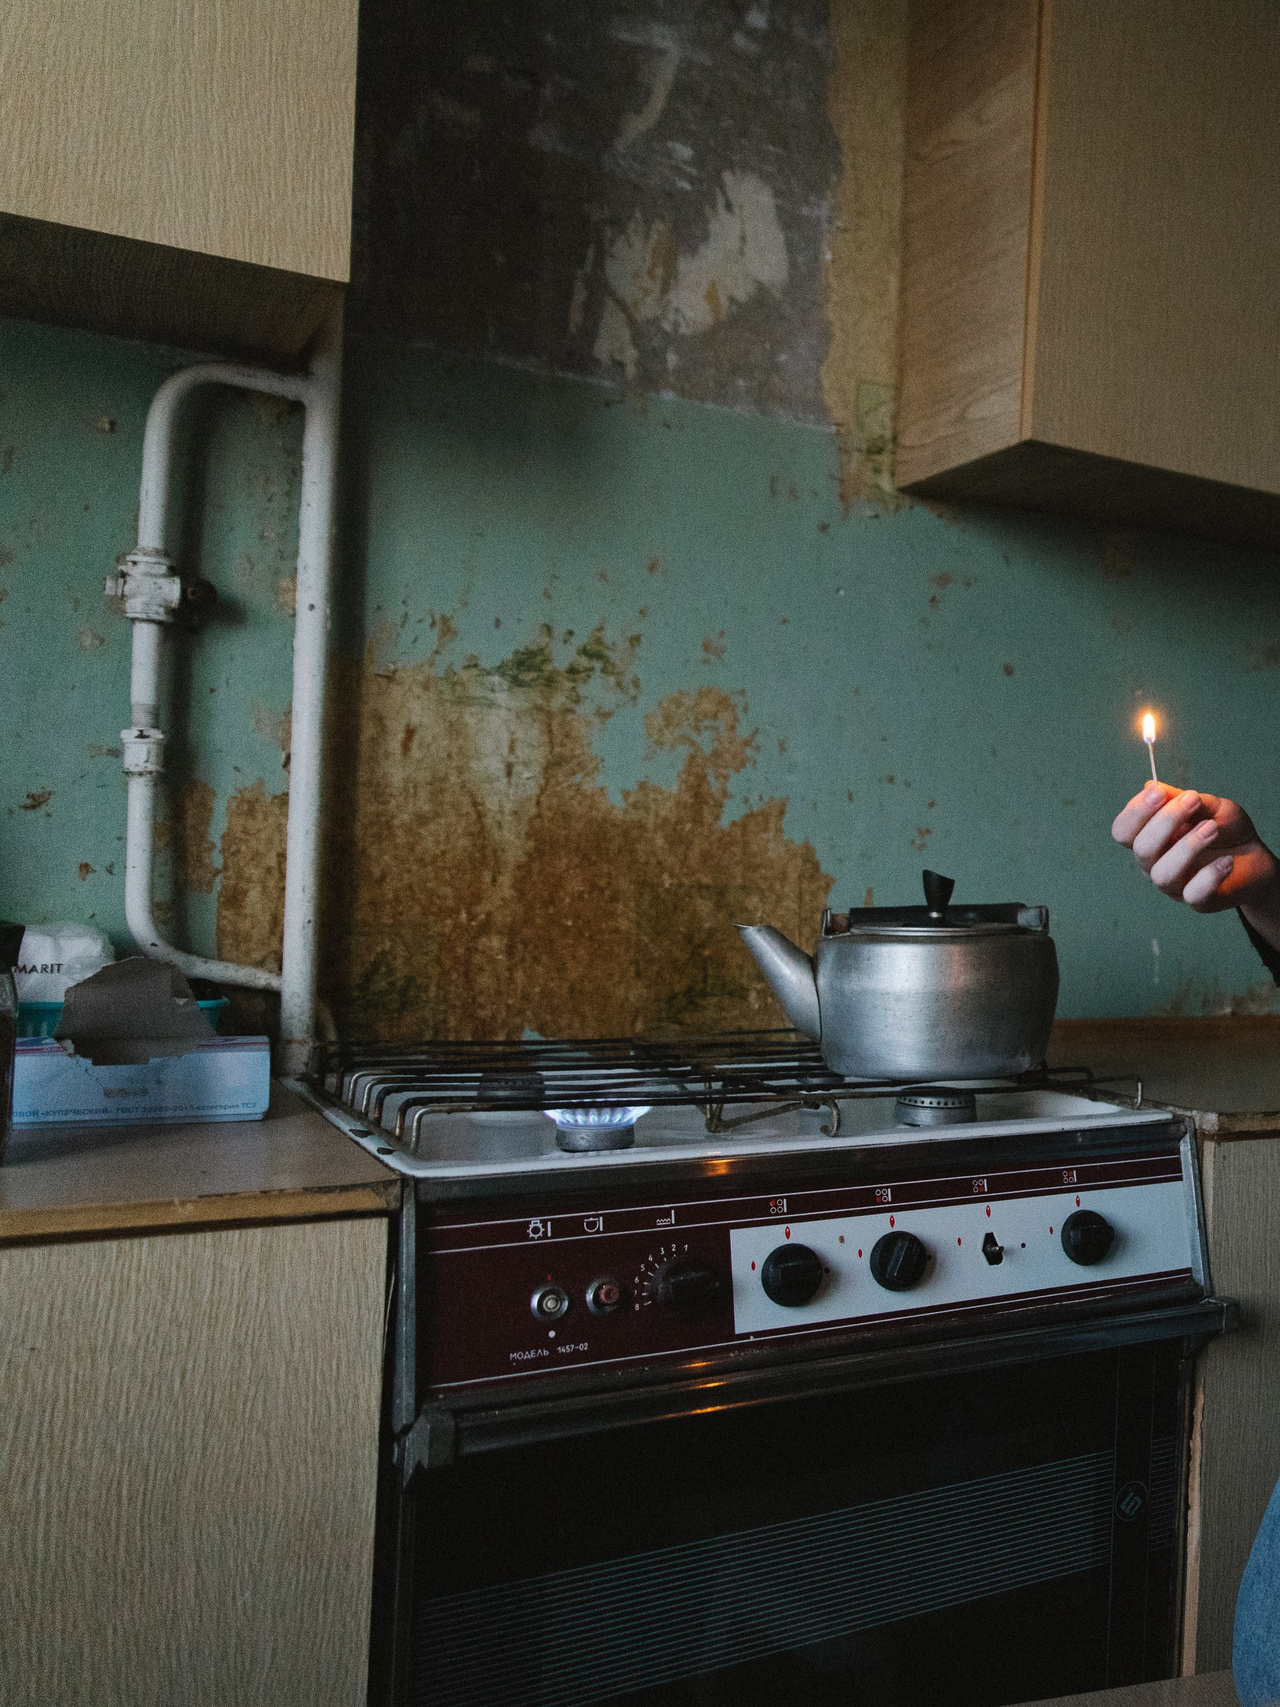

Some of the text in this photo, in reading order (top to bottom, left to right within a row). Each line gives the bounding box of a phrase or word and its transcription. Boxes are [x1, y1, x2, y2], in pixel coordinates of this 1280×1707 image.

[14, 963, 64, 974] MARIT
[509, 1342, 589, 1361] МОДЕЛЬ 1457-02
